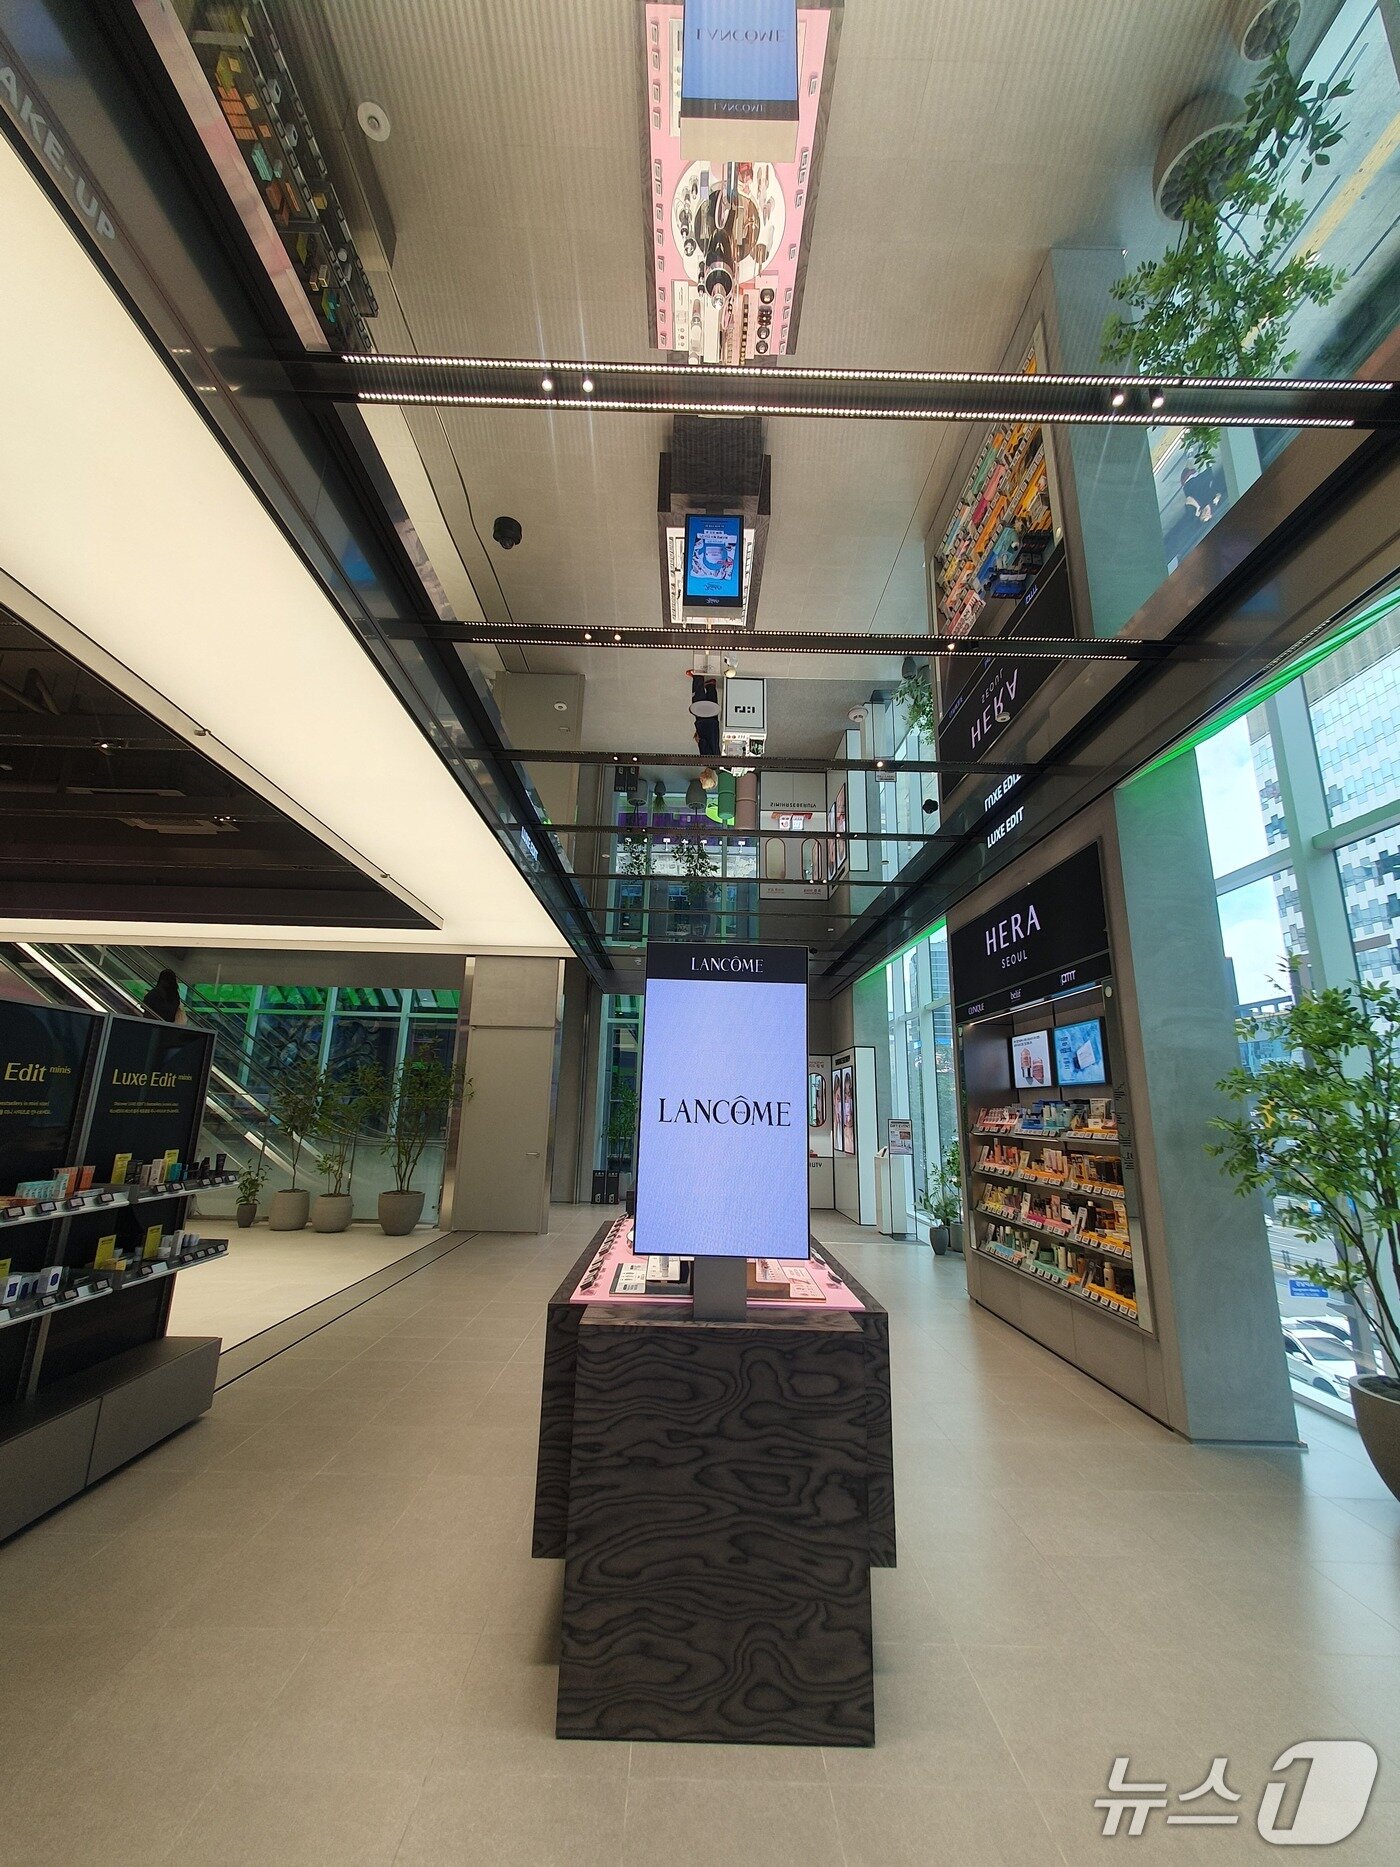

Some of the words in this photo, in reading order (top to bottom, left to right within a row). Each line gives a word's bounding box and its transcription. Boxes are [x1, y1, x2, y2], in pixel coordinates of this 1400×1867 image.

[987, 823, 1006, 849] LUXE
[1006, 805, 1024, 833] EDIT
[985, 904, 1041, 956] HERA
[691, 955, 764, 973] LANCÔME
[1001, 949, 1028, 969] SEOUL
[4, 1062, 47, 1082] Edit
[49, 1065, 72, 1074] minis
[112, 1068, 148, 1086] Luxe
[150, 1071, 177, 1088] Edit
[658, 1094, 791, 1127] LANCÔME
